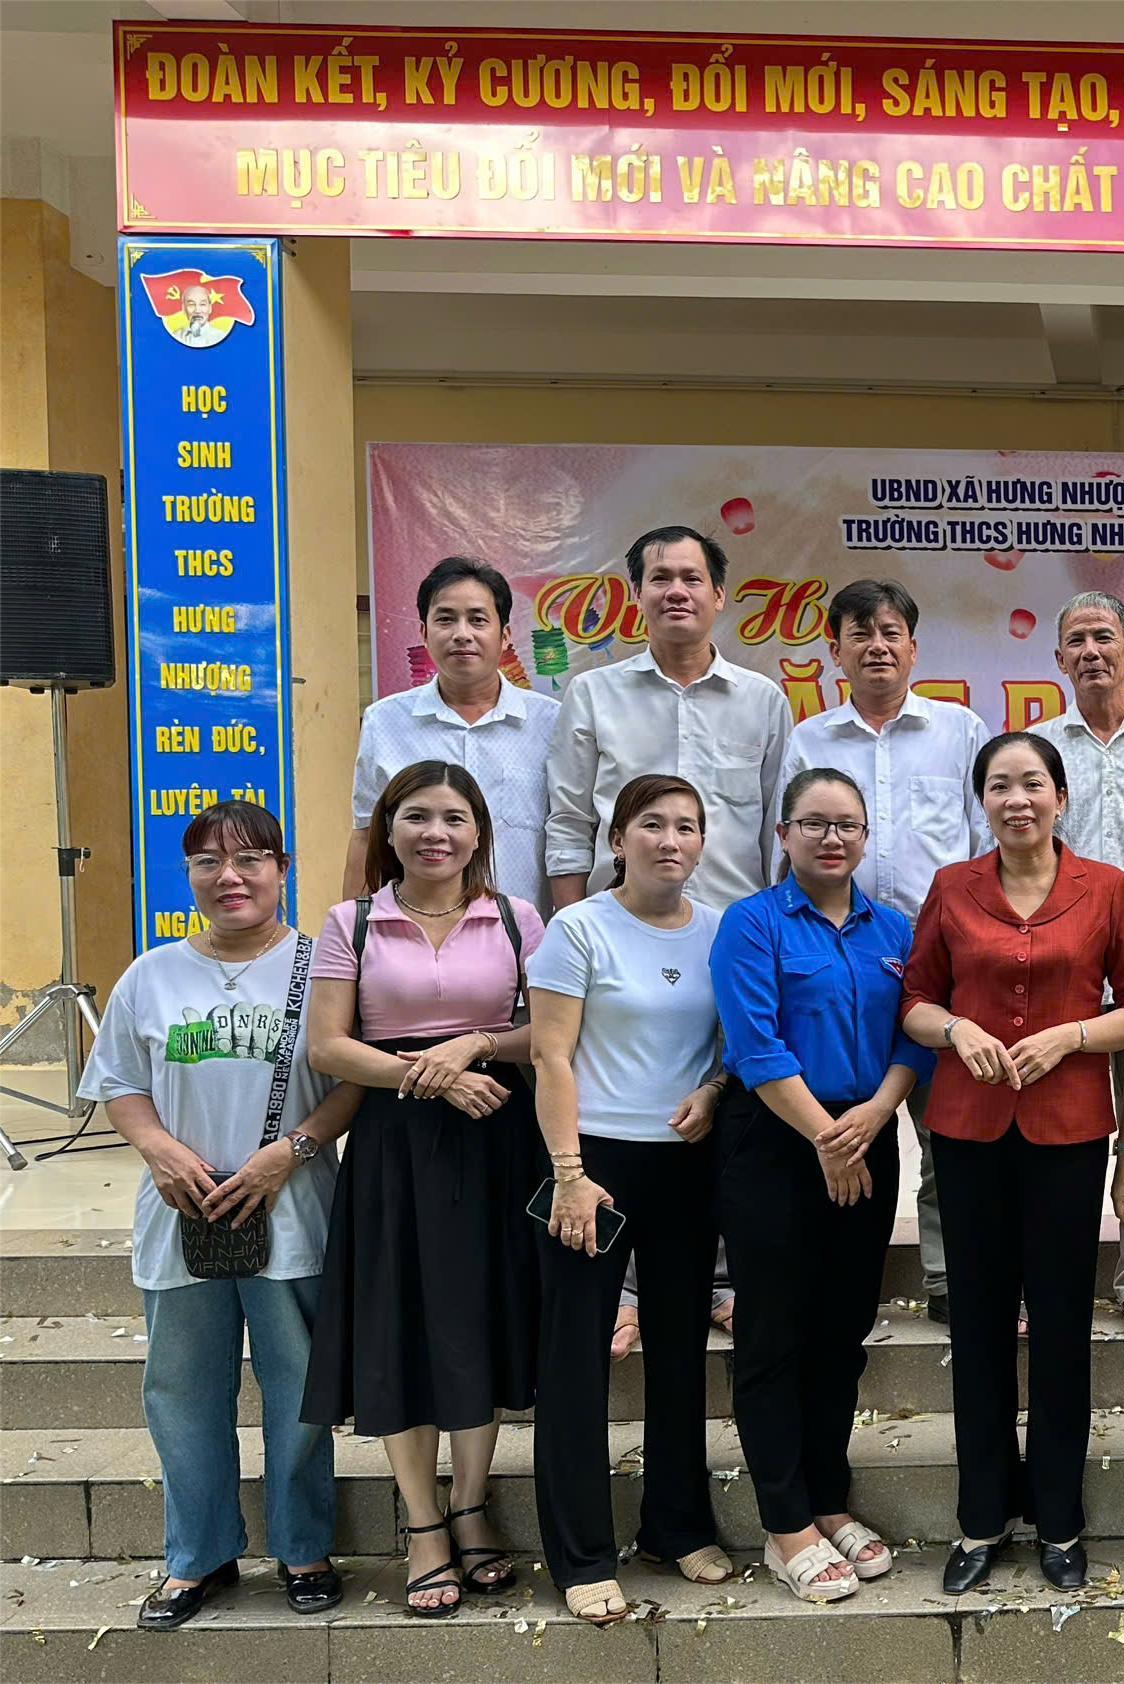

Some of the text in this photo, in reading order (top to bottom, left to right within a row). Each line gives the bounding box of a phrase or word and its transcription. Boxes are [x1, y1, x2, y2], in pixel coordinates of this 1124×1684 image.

[146, 44, 278, 103] ĐOÀN
[295, 37, 387, 111] KẾT,
[404, 41, 464, 106] KỶ
[479, 55, 654, 117] CƯƠNG,
[670, 44, 747, 113] ĐỔI
[765, 52, 866, 122] MỚI,
[882, 59, 1006, 118] SÁNG
[1022, 72, 1119, 131] TẠO,
[236, 148, 345, 209] MỤC
[359, 139, 461, 199] TIÊU
[476, 128, 555, 201] ĐỔI
[571, 144, 662, 203] MỚI
[677, 145, 737, 205] VÀ
[754, 147, 880, 208] NÂNG
[895, 162, 985, 210] CAO
[1002, 146, 1117, 212] CHẤT
[182, 386, 226, 418] HỌC
[178, 441, 231, 468] SINH
[162, 488, 255, 522] TRƯỜNG
[872, 478, 938, 502] UBND
[947, 476, 978, 503] XÃ
[987, 478, 1052, 505] HƯNG
[843, 514, 939, 544] TRƯỜNG
[947, 521, 1008, 544] THCS
[1017, 520, 1082, 546] HƯNG
[175, 550, 233, 576] THCS
[173, 604, 235, 632] HƯNG
[535, 574, 647, 644] Vu
[161, 662, 252, 696] NHƯỢNG
[156, 719, 265, 755] RÈN ĐỨC,
